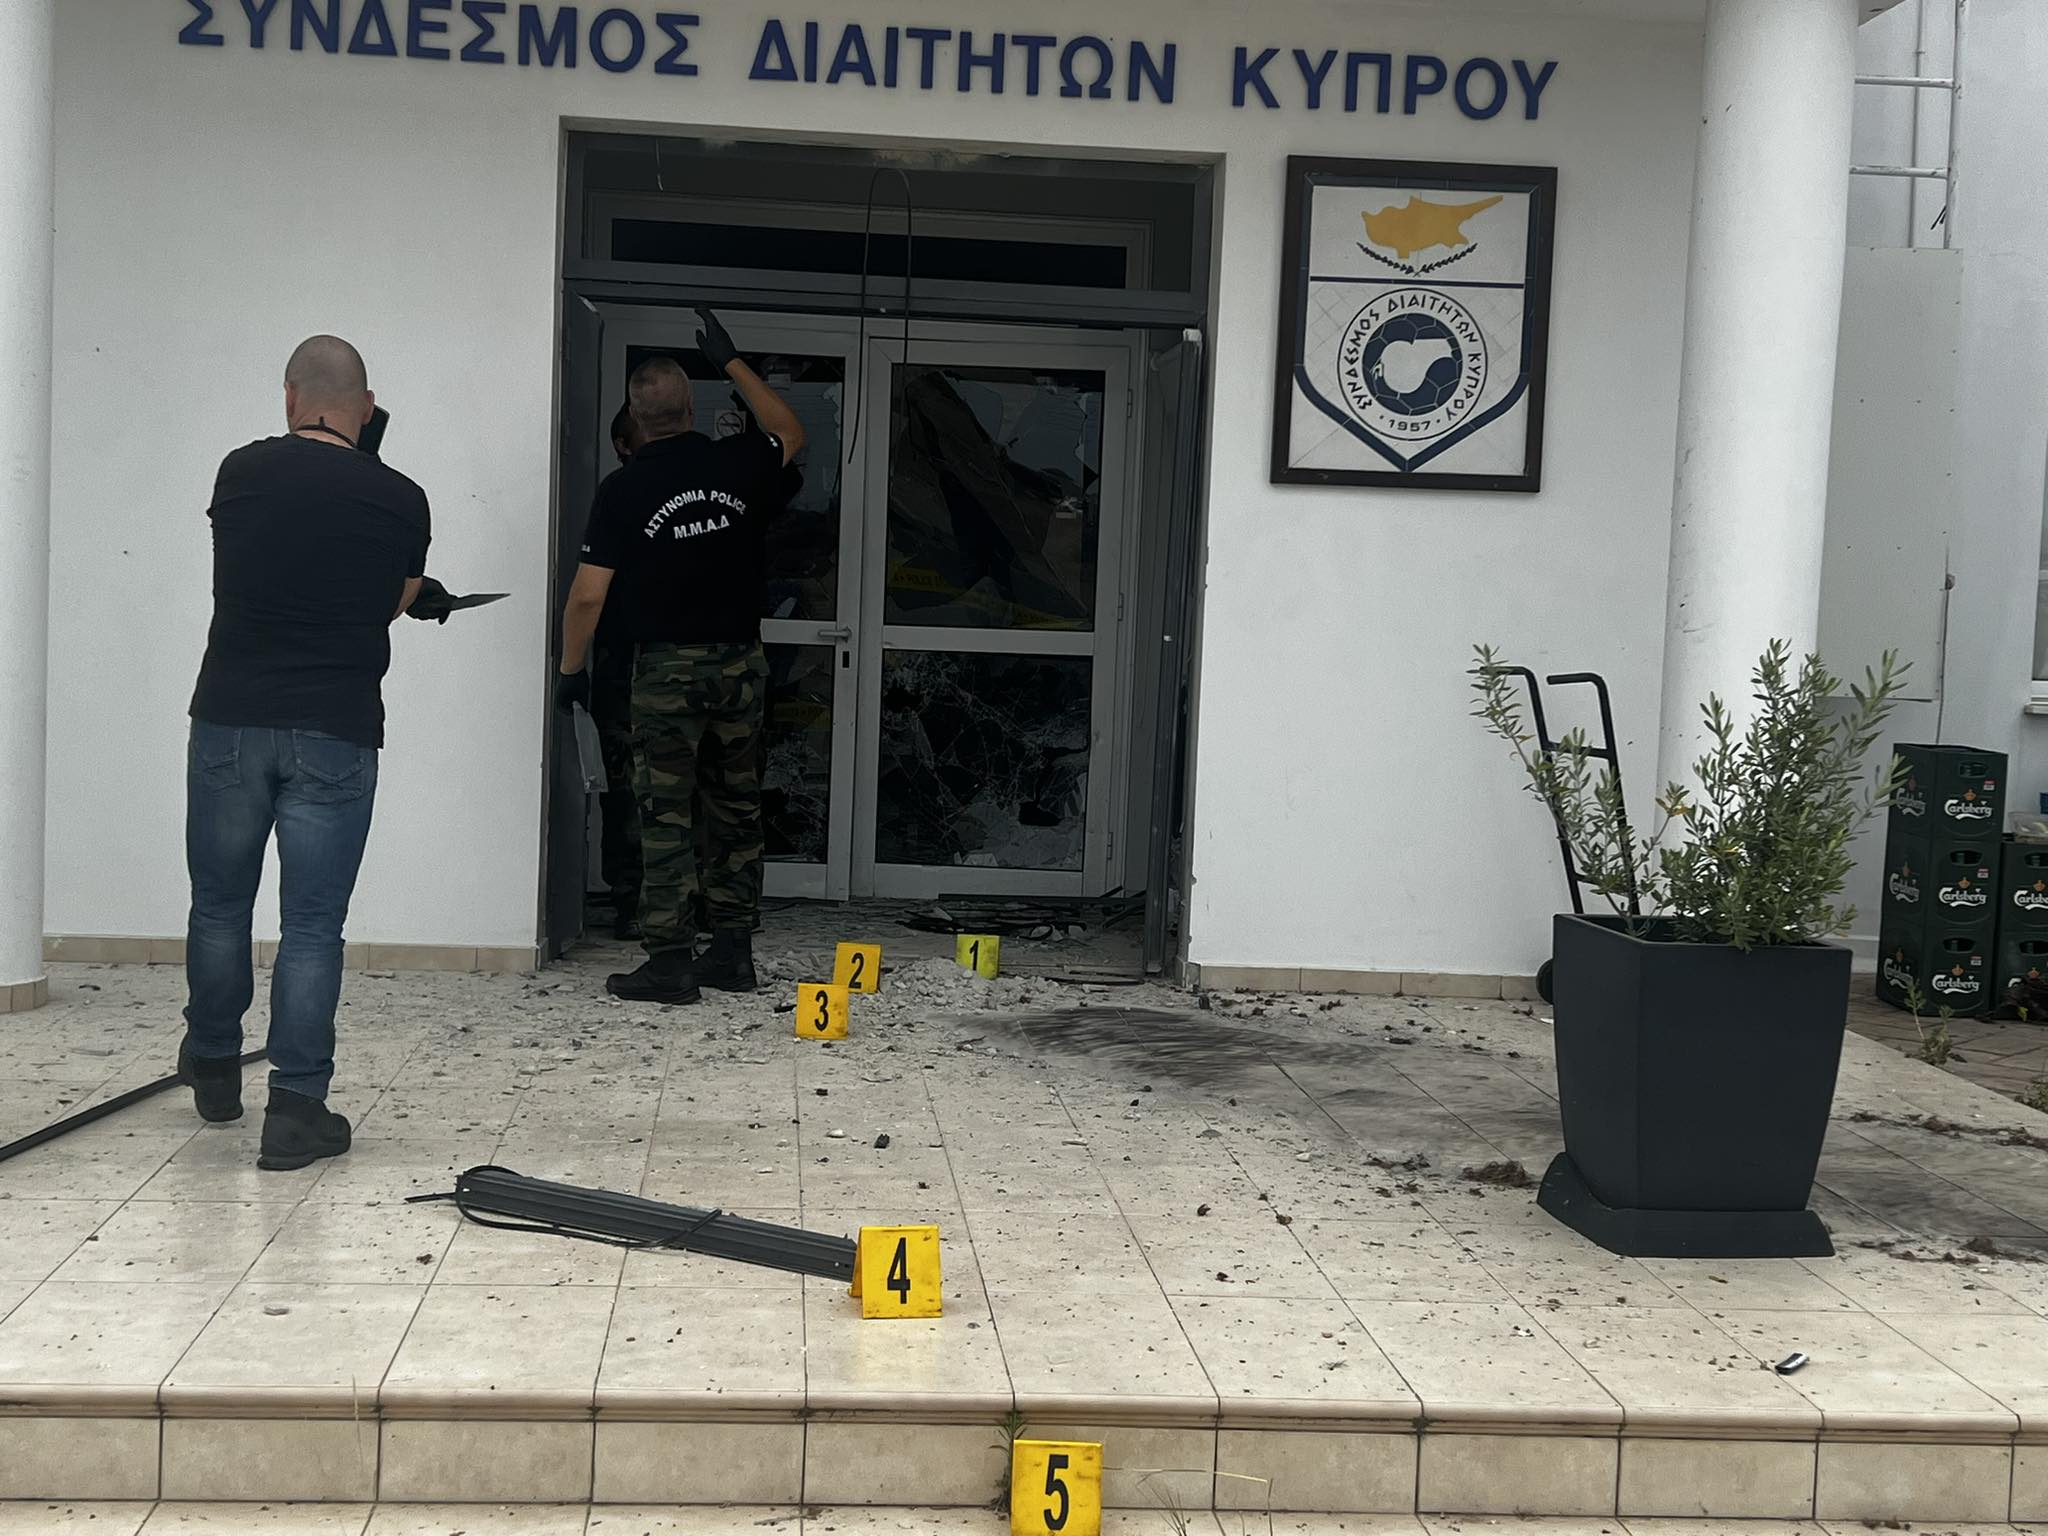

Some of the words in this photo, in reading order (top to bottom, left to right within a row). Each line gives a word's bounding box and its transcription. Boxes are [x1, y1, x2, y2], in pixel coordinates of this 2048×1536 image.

[179, 0, 700, 76] ΣΥΝΔΕΣΜΟΣ
[748, 19, 1177, 104] ΔΙΑΙΤΗΤΩΝ
[1232, 46, 1558, 120] ΚΥΠΡΟΥ
[1388, 294, 1479, 343] ΔΙΑΙΤΗΤΩΝ
[1446, 352, 1482, 421] ΚΥΠΡΟΥ
[1389, 419, 1431, 432] 1957
[644, 489, 706, 538] ΑΣΤΥΝΟΜΙΑ
[1944, 799, 1993, 820] Carlsberg
[1938, 886, 1987, 907] Carlsberg
[848, 952, 865, 989] 2
[968, 940, 980, 972] 1
[1932, 974, 1980, 995] Carlsberg
[814, 990, 829, 1032] 3
[887, 1236, 911, 1304] 4
[1043, 1454, 1069, 1531] 5
